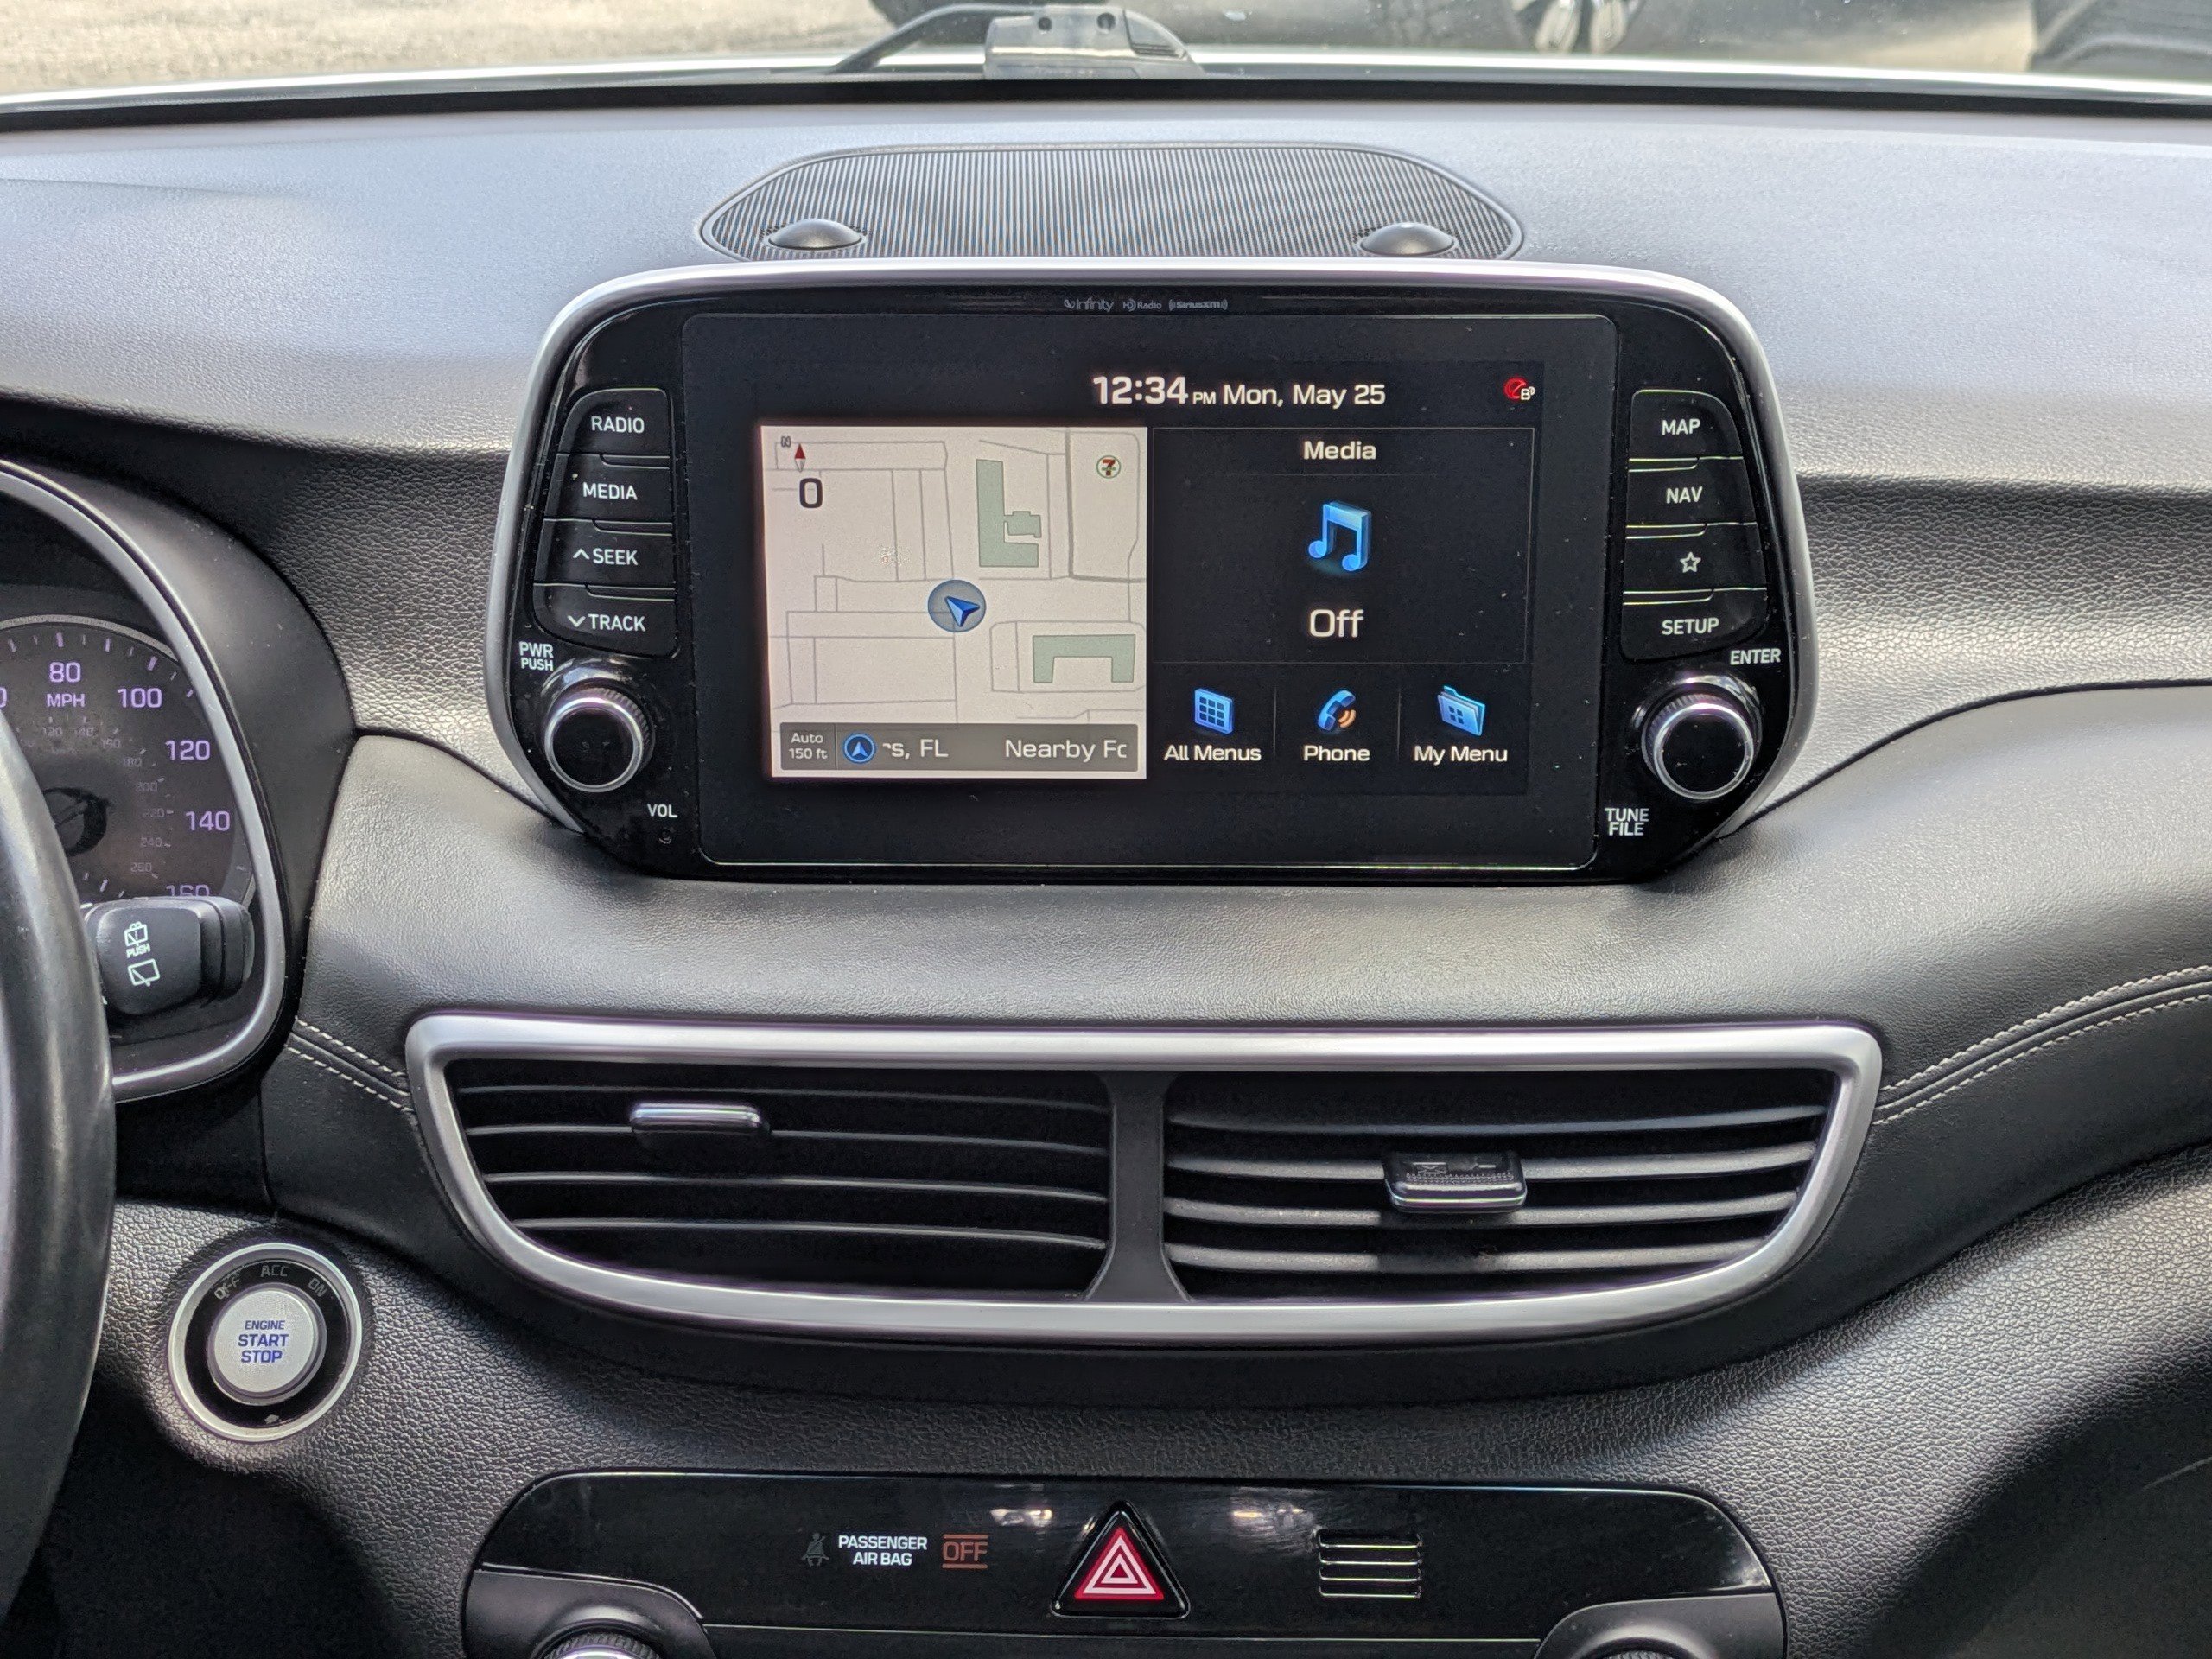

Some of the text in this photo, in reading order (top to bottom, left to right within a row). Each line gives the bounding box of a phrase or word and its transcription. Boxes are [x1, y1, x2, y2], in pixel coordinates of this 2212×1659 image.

[1137, 301, 1162, 309] Radio
[1093, 376, 1386, 410] 12:34 PM Mon, May 25
[591, 416, 645, 434] RADIO
[1661, 418, 1700, 435] MAP
[1303, 441, 1377, 460] Media
[582, 481, 638, 500] MEDIA
[799, 477, 823, 508] 0
[1666, 486, 1703, 504] NAV
[593, 548, 639, 566] SEEK
[588, 613, 646, 632] TRACK
[1309, 608, 1364, 638] Off
[1661, 617, 1719, 636] SETUP
[518, 641, 554, 658] PWR
[1730, 648, 1782, 665] ENTER
[49, 662, 81, 683] 80
[520, 658, 554, 671] PUSH
[46, 693, 86, 708] MPH
[117, 688, 162, 709] 100
[791, 732, 823, 744] Auto
[166, 741, 210, 760] 120
[788, 747, 828, 760] 150 ft
[920, 738, 950, 758] FL
[1005, 739, 1096, 763] Nearby
[1164, 745, 1262, 762] All Menus
[1303, 745, 1370, 762] Phone
[1414, 745, 1508, 766] My Menu
[646, 803, 678, 818] VOL
[1605, 807, 1649, 823] TUNE
[185, 810, 231, 832] 140
[1609, 821, 1644, 836] FILE
[126, 943, 151, 959] PUSH
[260, 1263, 289, 1278] ACC
[308, 1277, 328, 1297] ON
[245, 1319, 286, 1331] ENGINE
[238, 1333, 289, 1347] START
[240, 1350, 283, 1363] STOP
[838, 1535, 928, 1550] PASSENGER
[852, 1551, 912, 1567] AIR BAG
[942, 1541, 988, 1562] OFF
